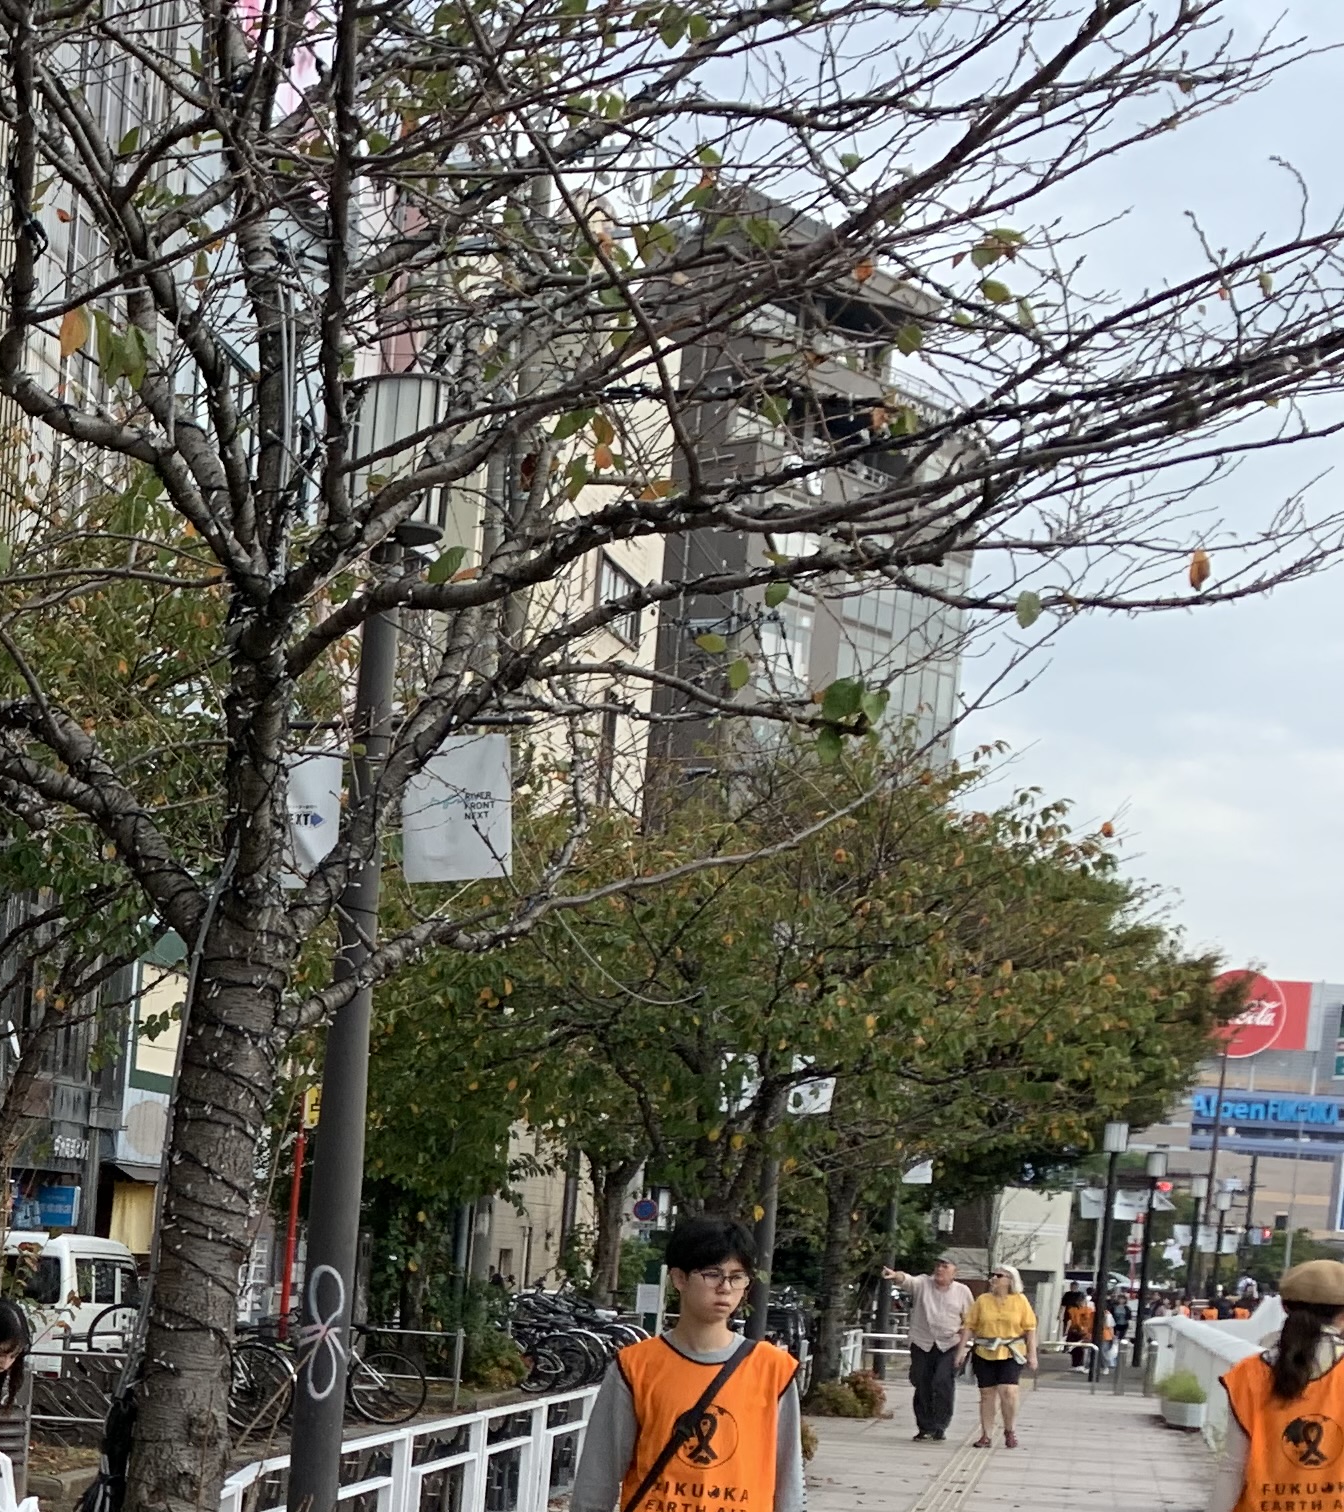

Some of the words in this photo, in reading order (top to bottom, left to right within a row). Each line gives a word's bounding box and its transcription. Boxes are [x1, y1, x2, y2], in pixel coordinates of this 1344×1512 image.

[464, 791, 492, 801] RIVER
[464, 801, 495, 810] FRONT
[464, 811, 489, 820] NEXT
[1192, 1094, 1264, 1121] Alpen
[1260, 1500, 1322, 1512] EARTH
